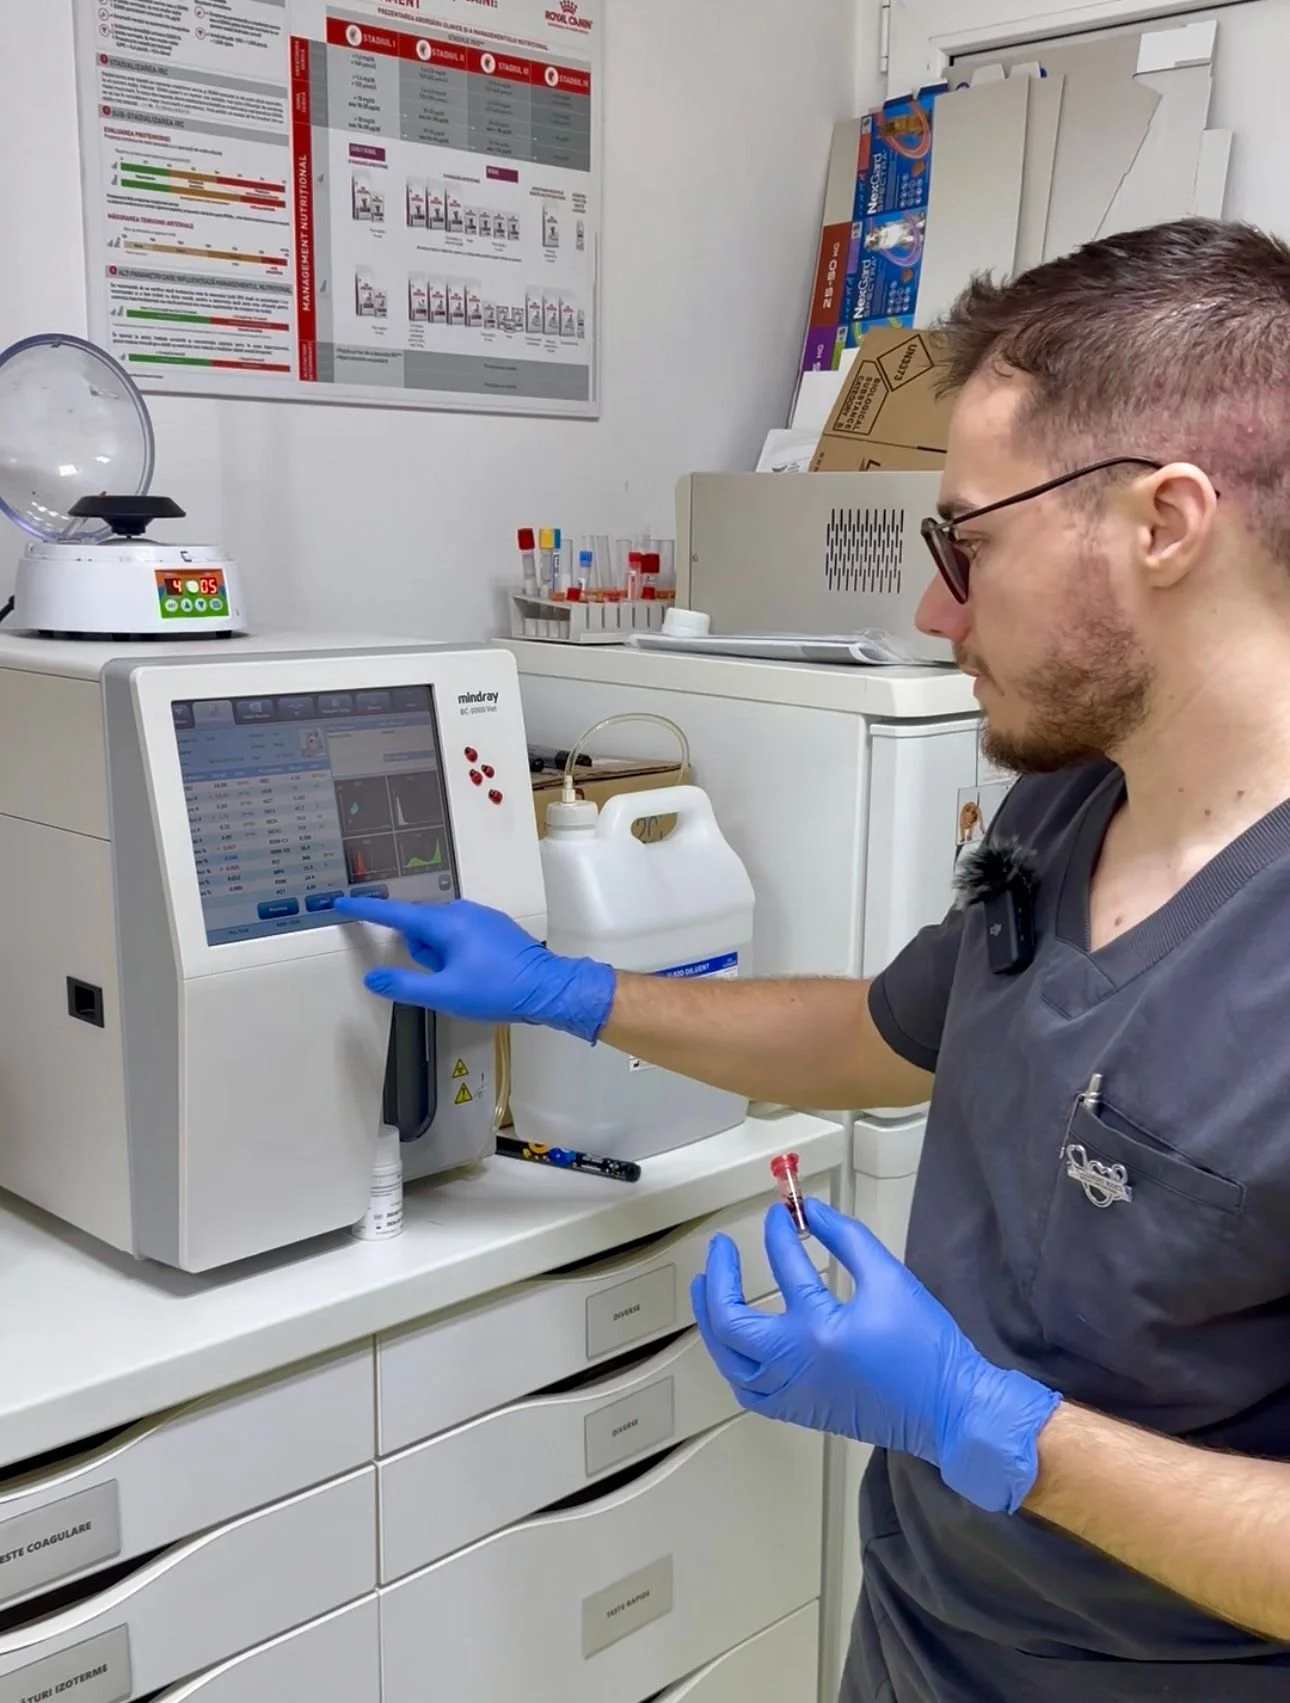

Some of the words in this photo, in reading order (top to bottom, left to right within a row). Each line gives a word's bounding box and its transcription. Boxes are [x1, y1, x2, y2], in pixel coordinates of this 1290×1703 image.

[363, 33, 392, 47] STADIUL
[432, 48, 459, 61] STADIUL
[498, 61, 523, 75] STADIUL
[559, 75, 582, 87] STADIUL
[867, 153, 882, 215] NexGard
[301, 231, 311, 312] MANAGEMENT
[823, 259, 837, 309] 25-50
[853, 259, 871, 319] NexGard
[894, 343, 918, 381] UN3373
[842, 375, 865, 417] CATEGORY
[844, 376, 873, 429] SUBSTANCE
[852, 377, 881, 431] BIOLOGICAL
[173, 579, 182, 593] 4
[200, 578, 217, 594] 05
[458, 690, 499, 704] mindray
[613, 1303, 641, 1321] DIVERSE
[611, 1418, 639, 1437] DIVERSE
[0, 1547, 25, 1565] ESTE
[26, 1520, 93, 1554] COAGULARE
[55, 1663, 108, 1695] IZOTERME
